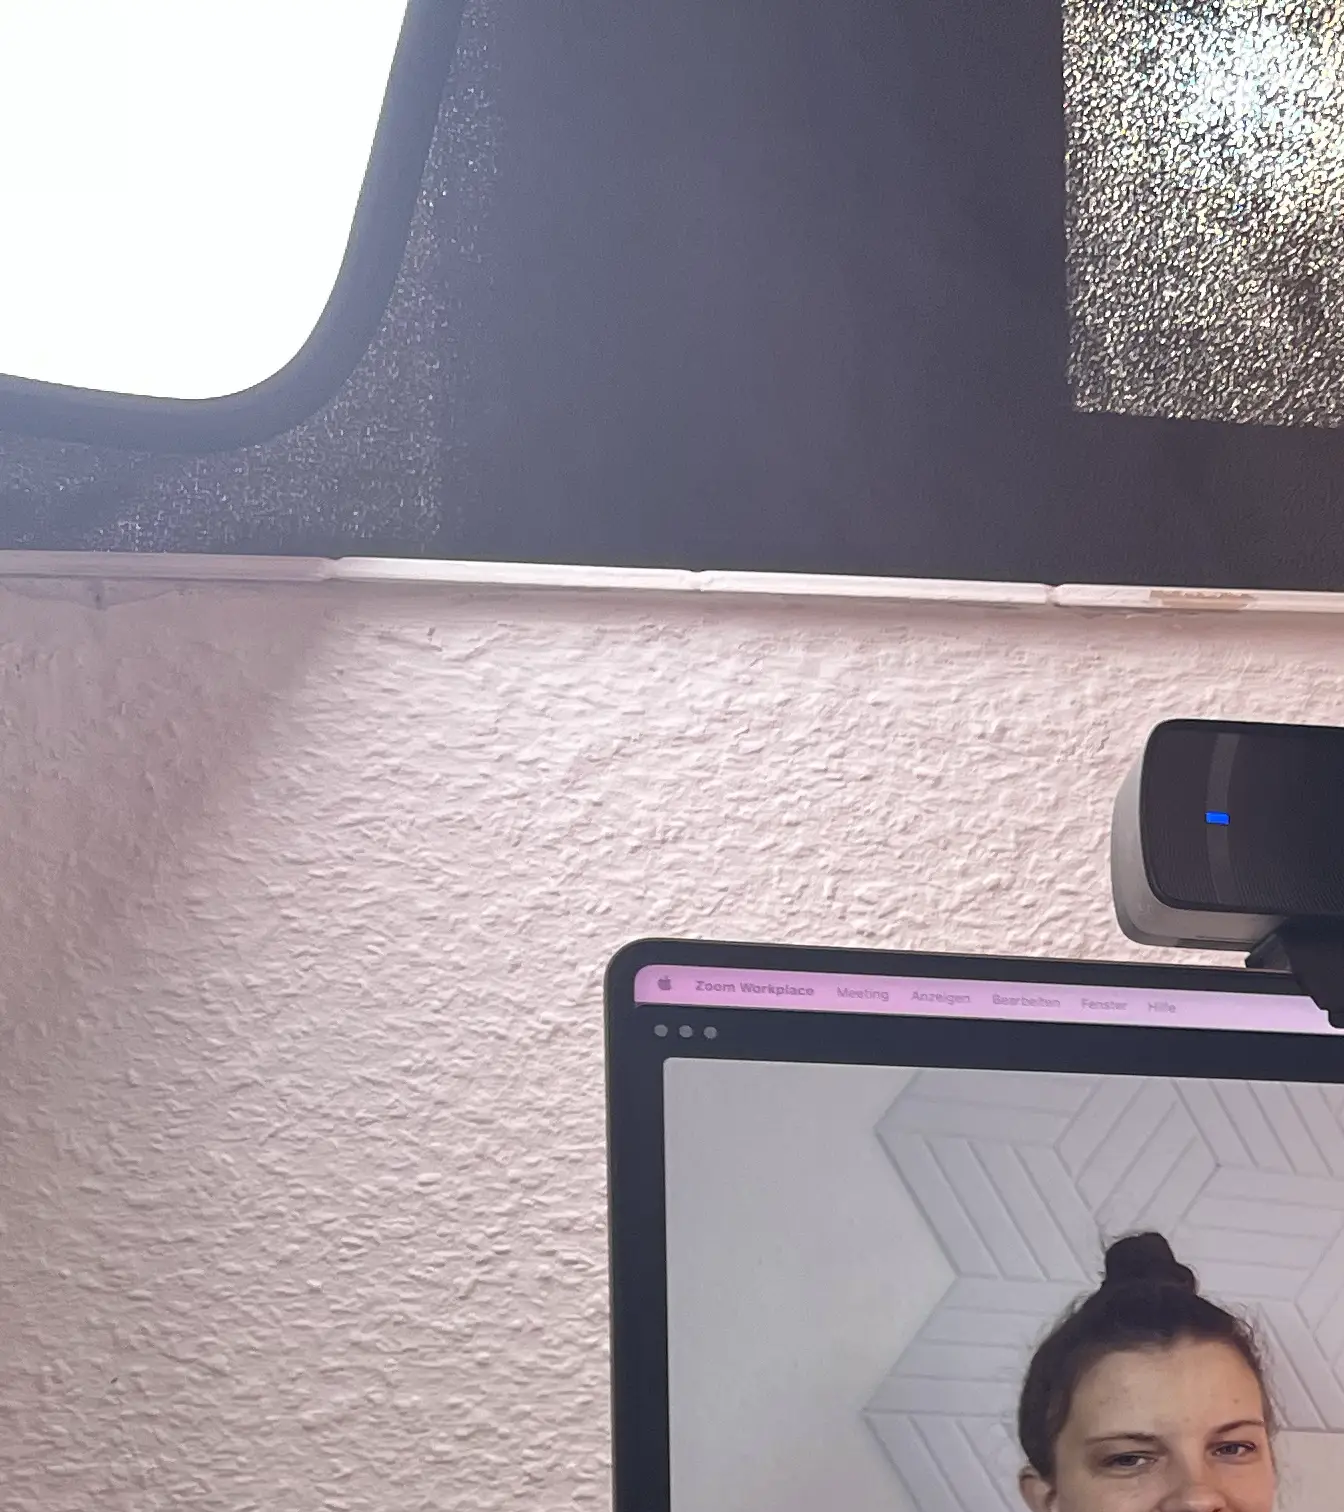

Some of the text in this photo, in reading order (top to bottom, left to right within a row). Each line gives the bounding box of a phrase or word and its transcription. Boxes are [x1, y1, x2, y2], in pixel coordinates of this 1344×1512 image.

[695, 980, 736, 993] Zoom
[740, 982, 814, 996] Workplace
[836, 987, 889, 1001] Meeting
[911, 990, 971, 1005] Anzeigen
[1081, 998, 1128, 1011] Fenster
